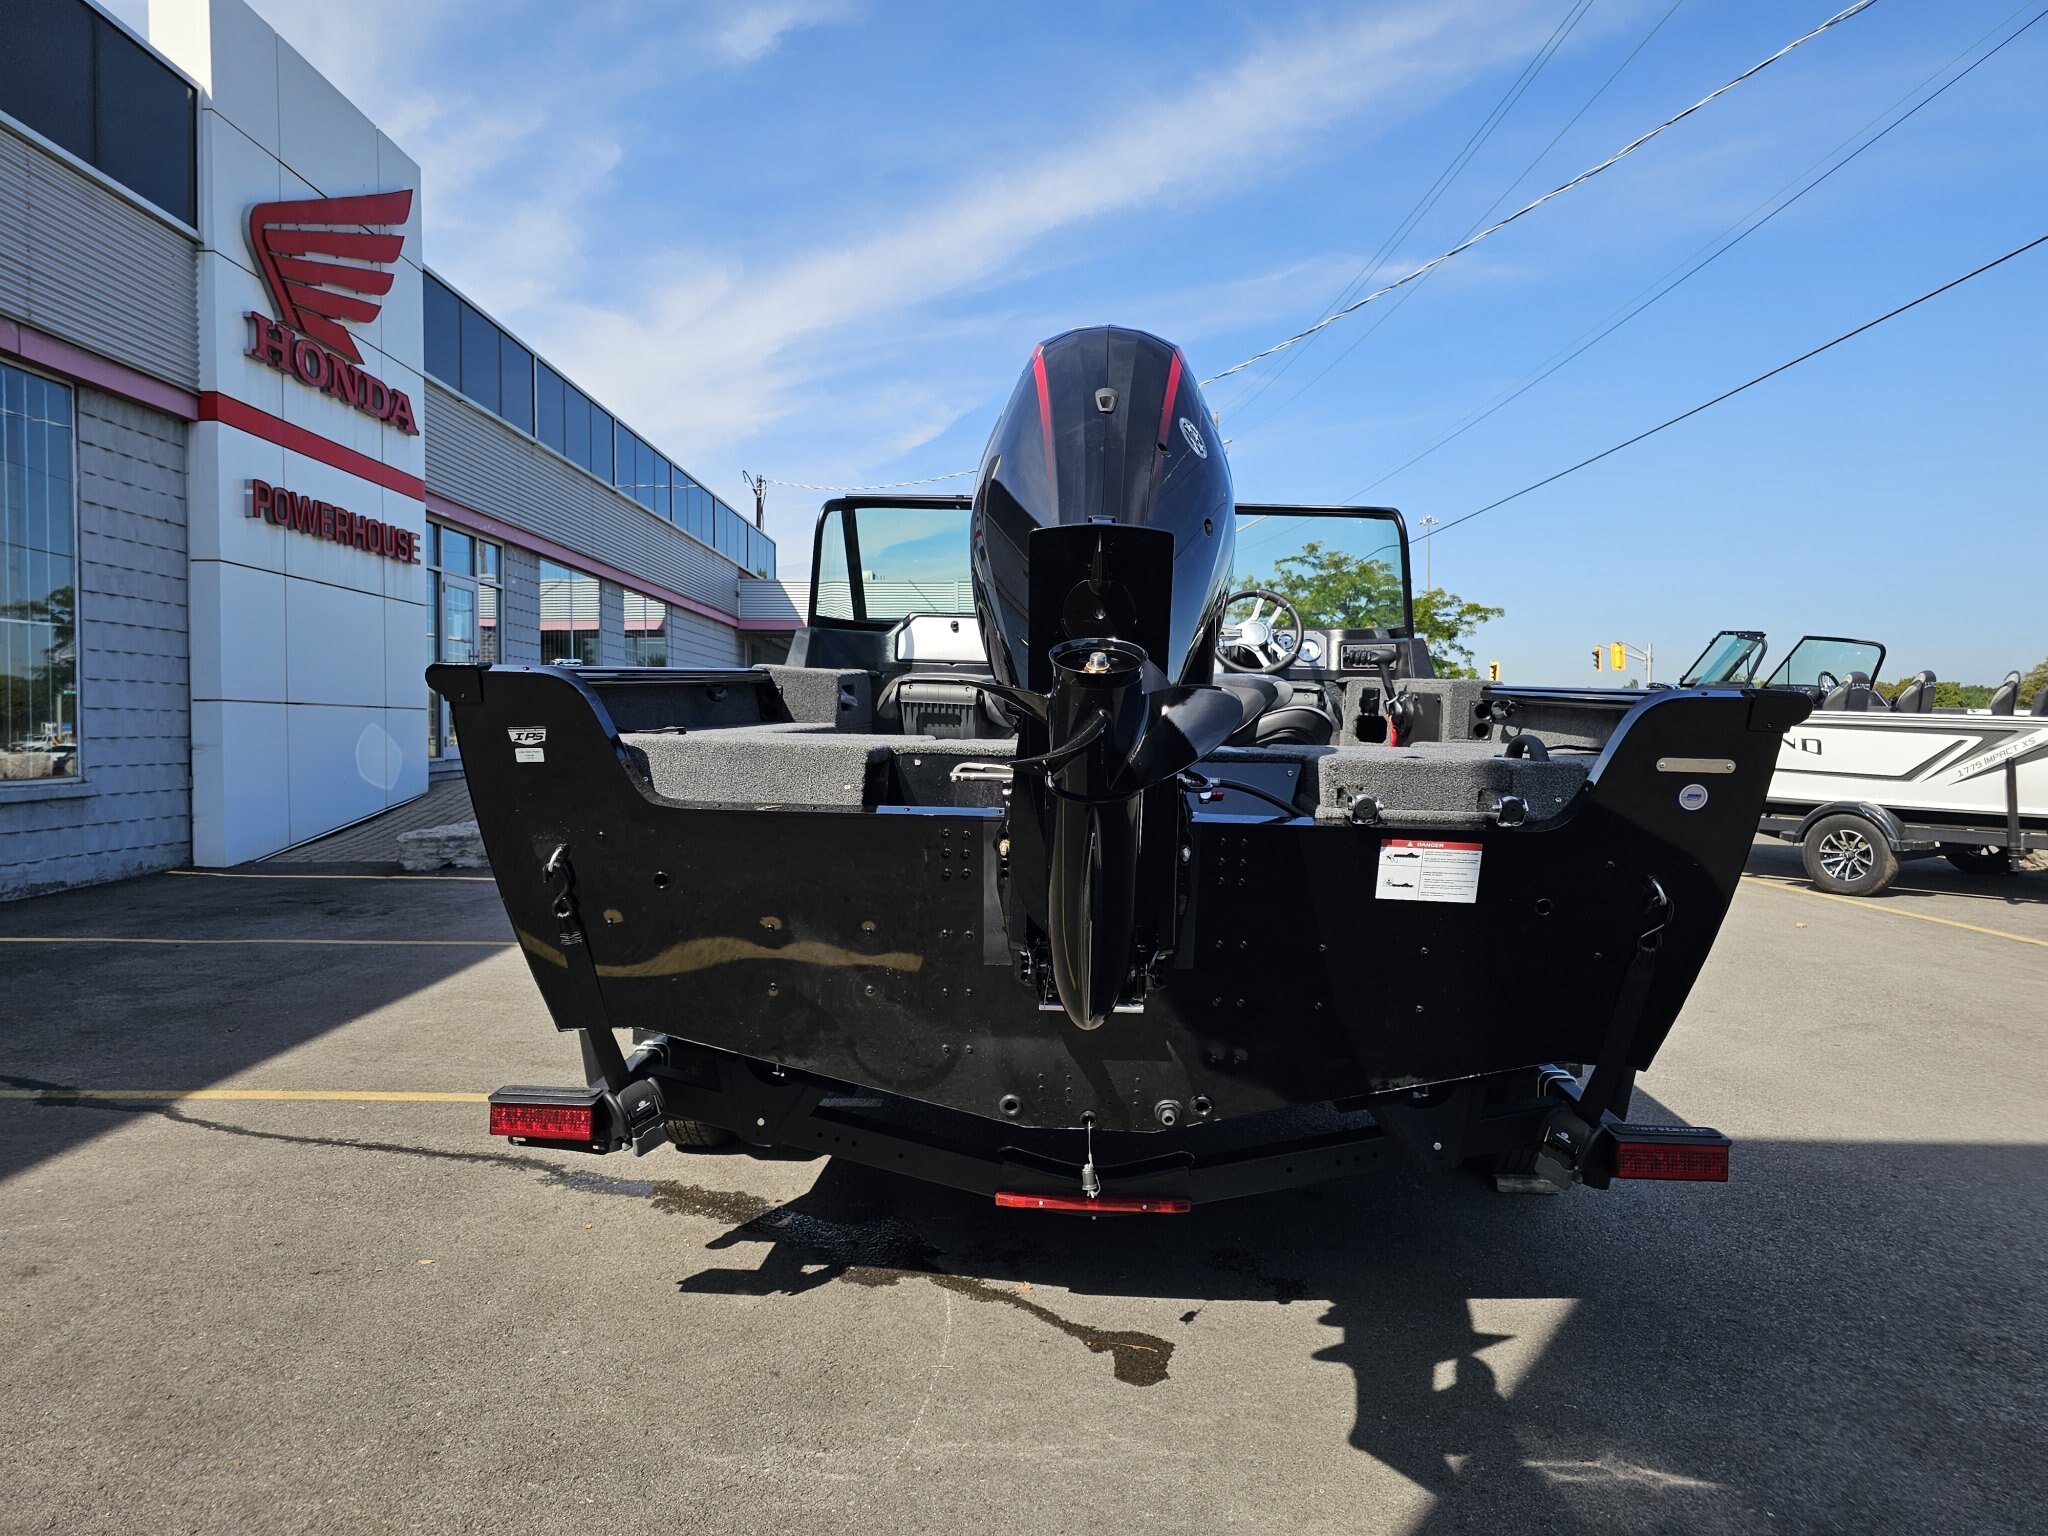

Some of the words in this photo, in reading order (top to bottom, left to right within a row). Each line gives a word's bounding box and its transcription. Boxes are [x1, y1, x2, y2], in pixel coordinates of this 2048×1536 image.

[244, 310, 420, 436] HONDA
[246, 478, 421, 565] POWERHOUSE
[514, 733, 544, 741] IPS
[1782, 738, 1822, 755] ND
[1957, 760, 1983, 778] 1775
[1983, 744, 2018, 765] IMPACT
[2022, 736, 2036, 747] XS
